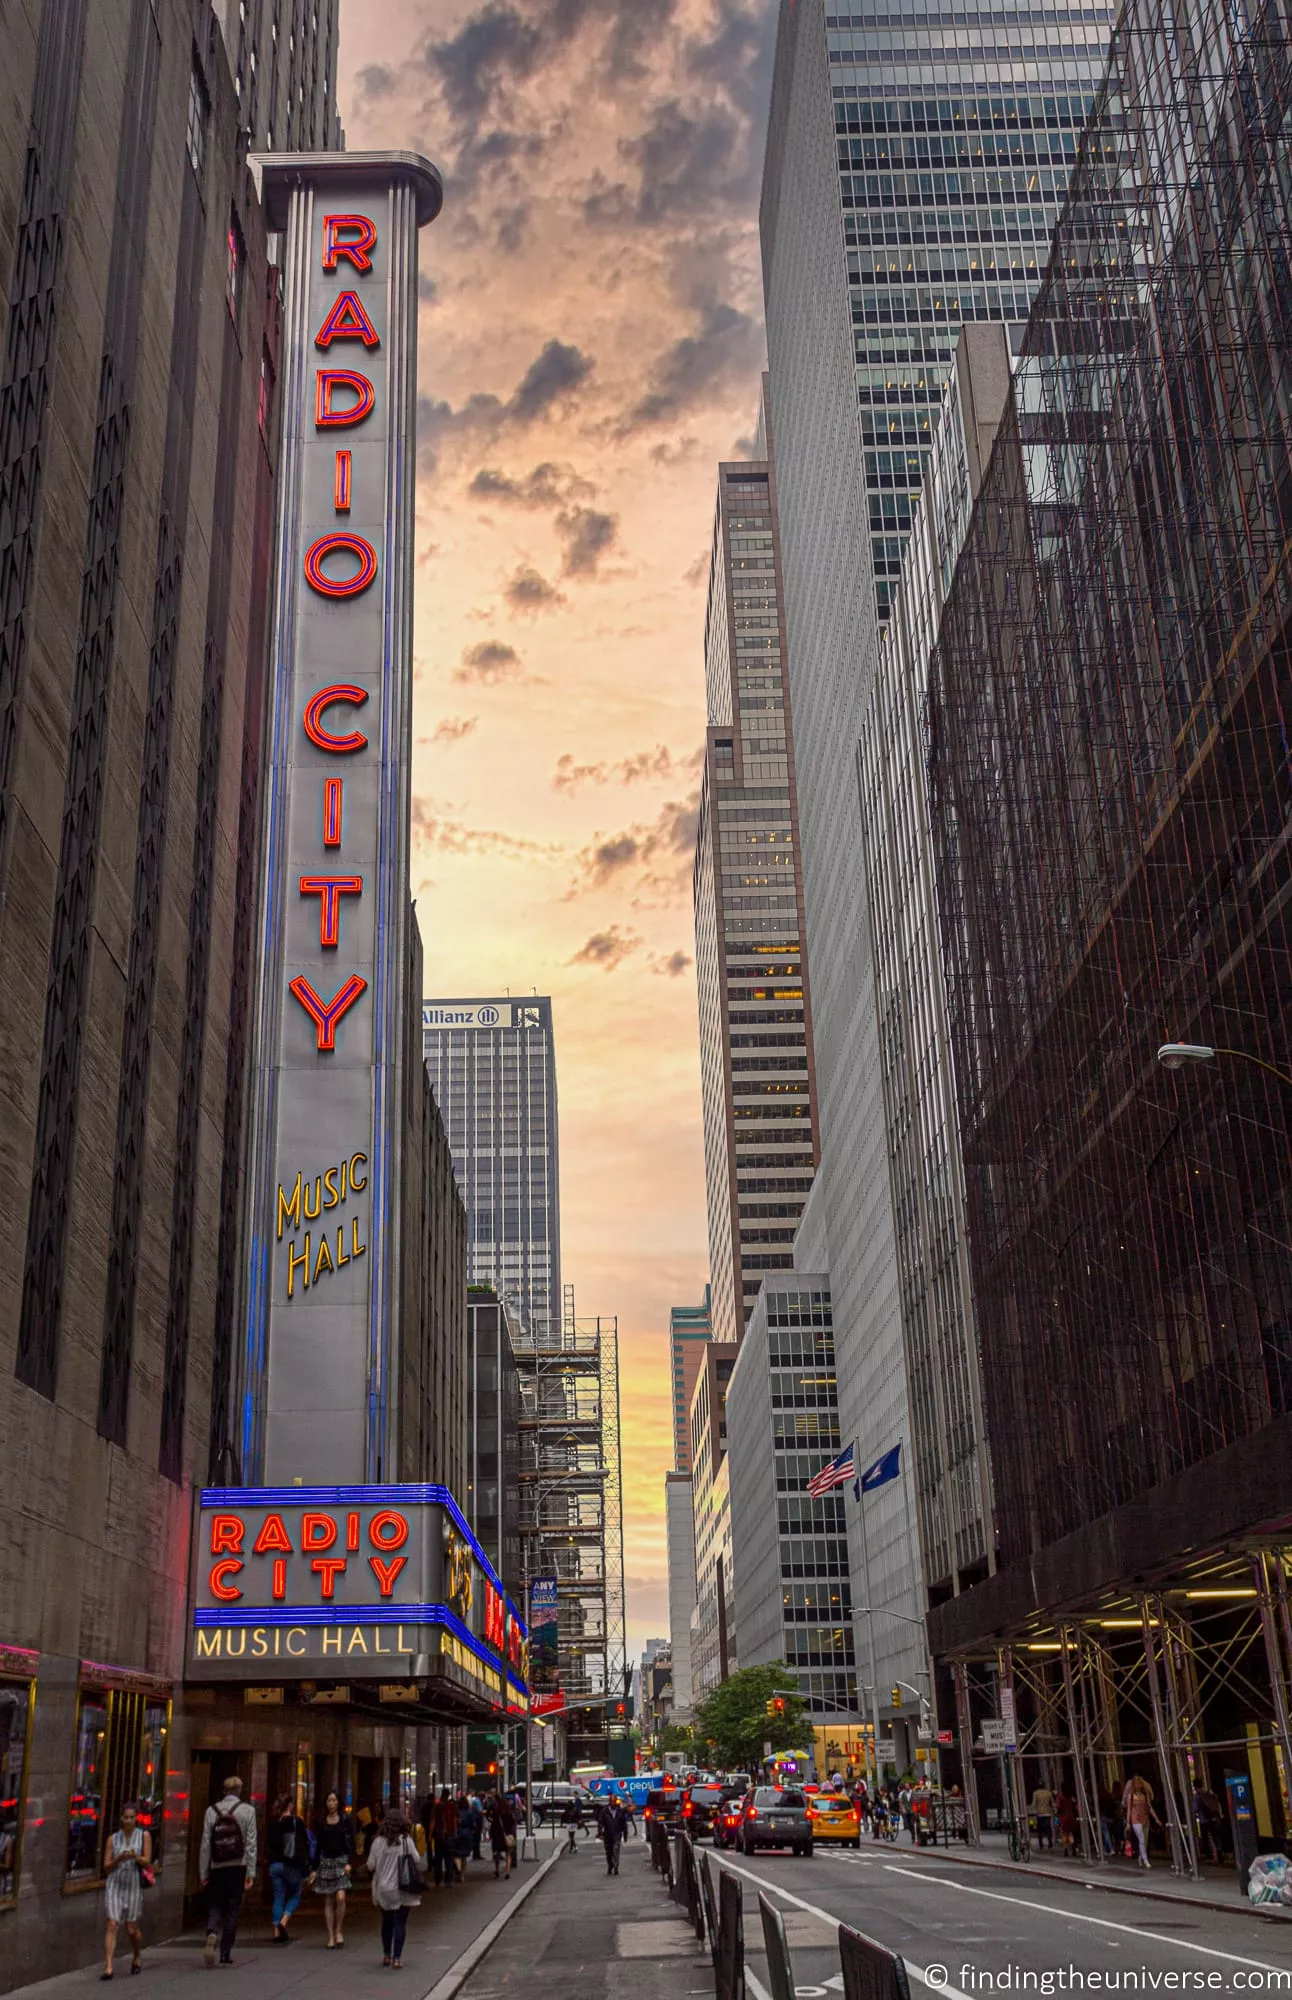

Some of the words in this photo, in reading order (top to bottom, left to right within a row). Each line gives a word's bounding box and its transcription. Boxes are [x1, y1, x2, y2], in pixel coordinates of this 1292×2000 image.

[304, 214, 380, 597] RADIO
[289, 684, 369, 1052] CITY
[287, 1216, 366, 1298] HALL
[211, 1510, 409, 1554] RADIO
[209, 1557, 408, 1600] CITY
[197, 1628, 307, 1656] MUSIC
[322, 1625, 414, 1654] HALL
